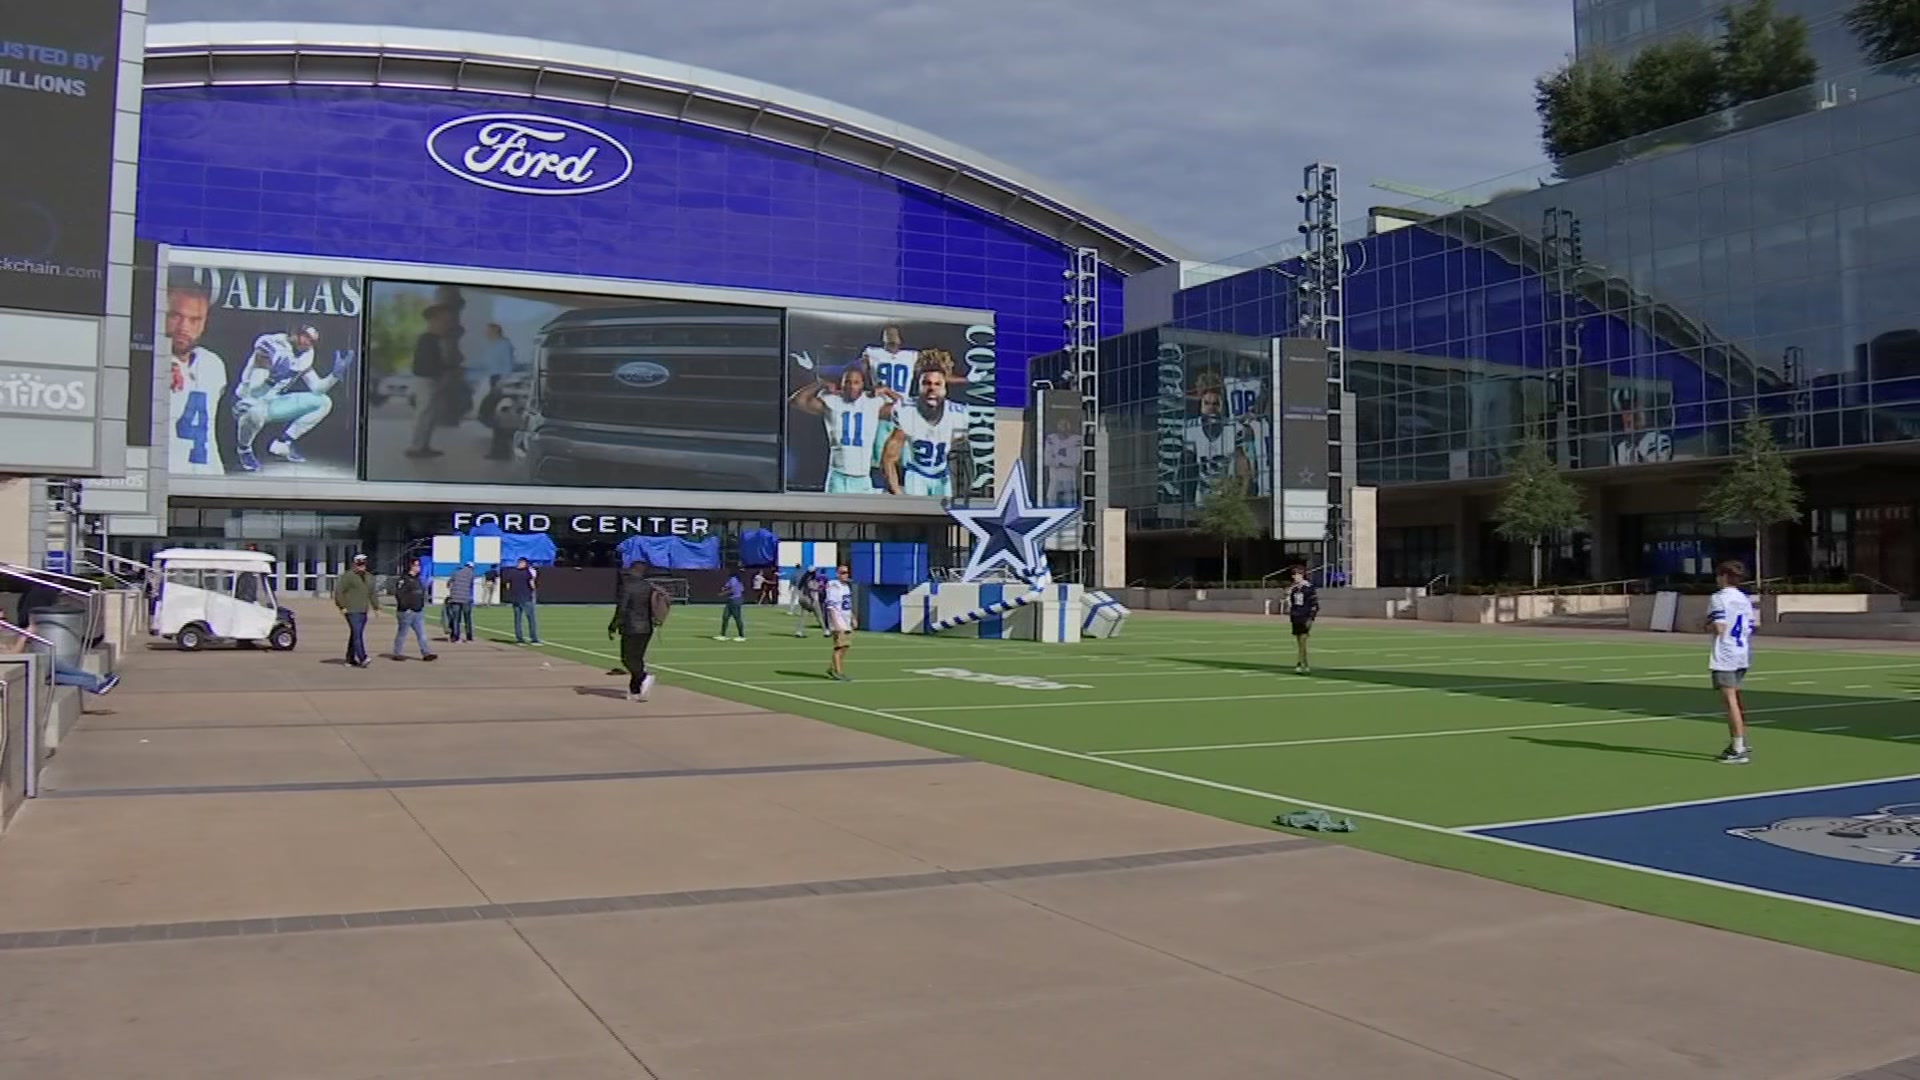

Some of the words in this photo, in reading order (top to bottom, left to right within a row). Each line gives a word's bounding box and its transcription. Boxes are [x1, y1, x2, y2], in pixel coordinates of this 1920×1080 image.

[73, 52, 104, 72] BY
[0, 68, 86, 97] ILLIONS
[464, 122, 598, 183] Ford
[193, 266, 361, 317] DALLAS
[876, 363, 909, 393] 90
[965, 325, 995, 490] COWBOYS
[176, 391, 208, 464] 4
[841, 411, 863, 446] 11
[912, 440, 947, 467] 21
[454, 512, 551, 531] FORD
[572, 515, 709, 534] CENTER
[1731, 614, 1744, 648] 4
